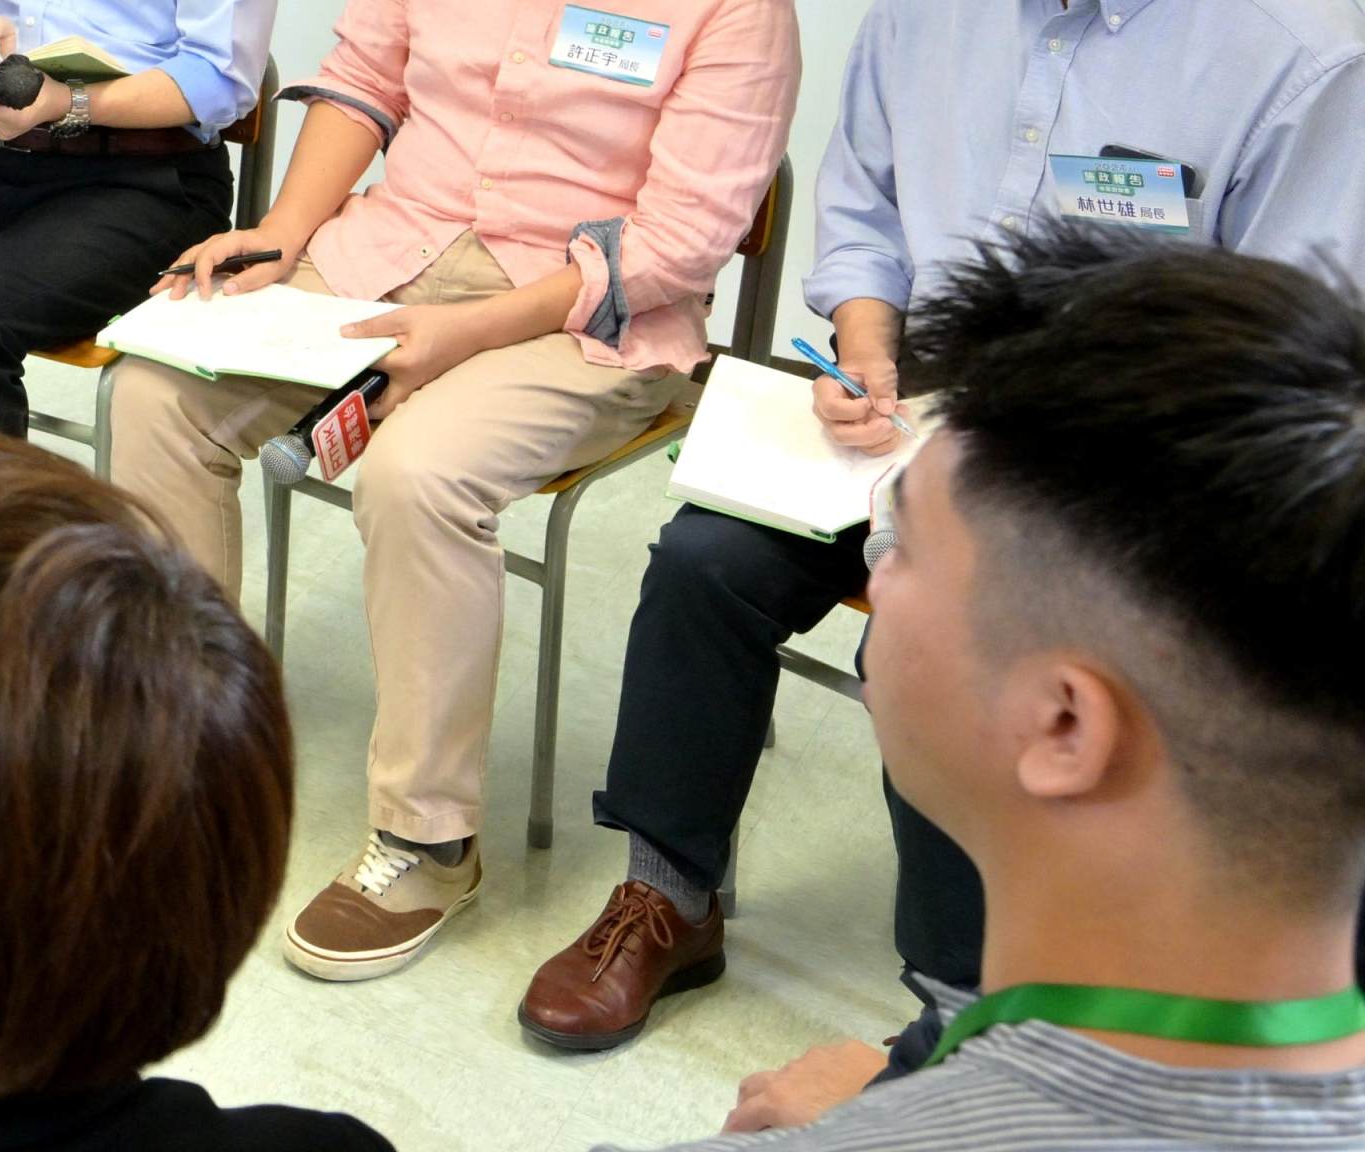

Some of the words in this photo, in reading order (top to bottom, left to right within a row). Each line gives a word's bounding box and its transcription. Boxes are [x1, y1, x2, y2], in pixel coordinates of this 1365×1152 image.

[567, 43, 618, 66] 許正宇
[1076, 195, 1137, 218] 林世雄
[323, 423, 343, 472] RTHK
